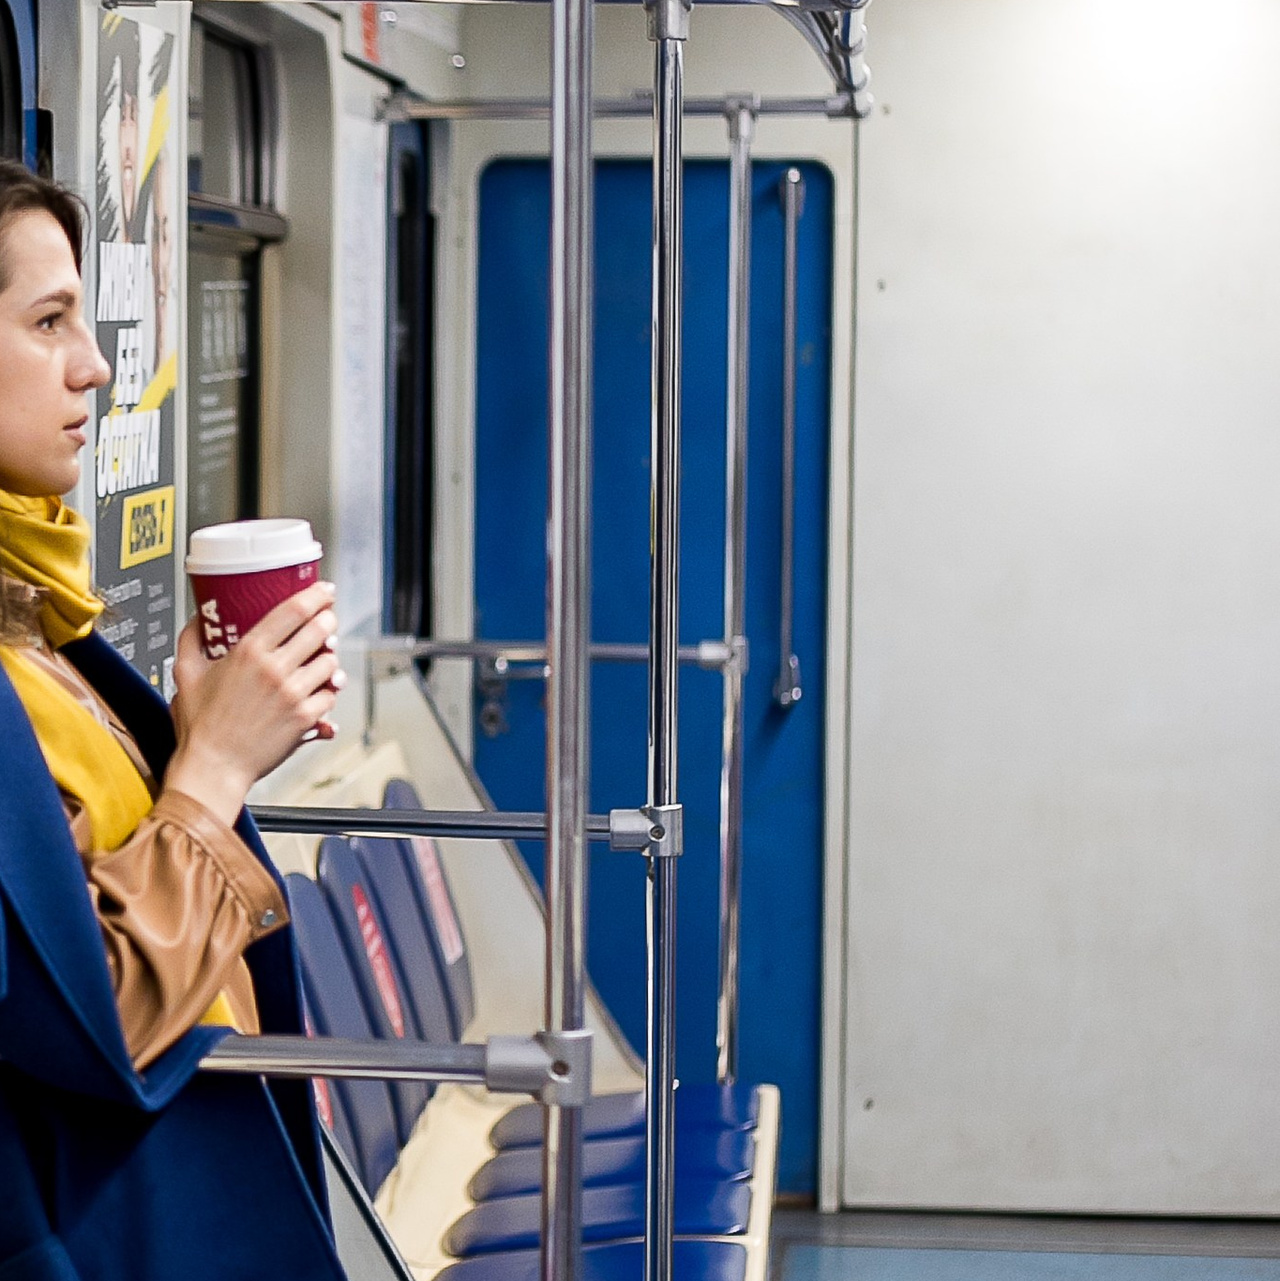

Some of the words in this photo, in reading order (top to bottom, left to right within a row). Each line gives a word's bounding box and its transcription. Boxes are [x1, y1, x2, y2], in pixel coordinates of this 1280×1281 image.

[115, 328, 143, 405] БЕЗ
[97, 409, 161, 498] ОСТАТКА
[200, 598, 229, 657] STA
